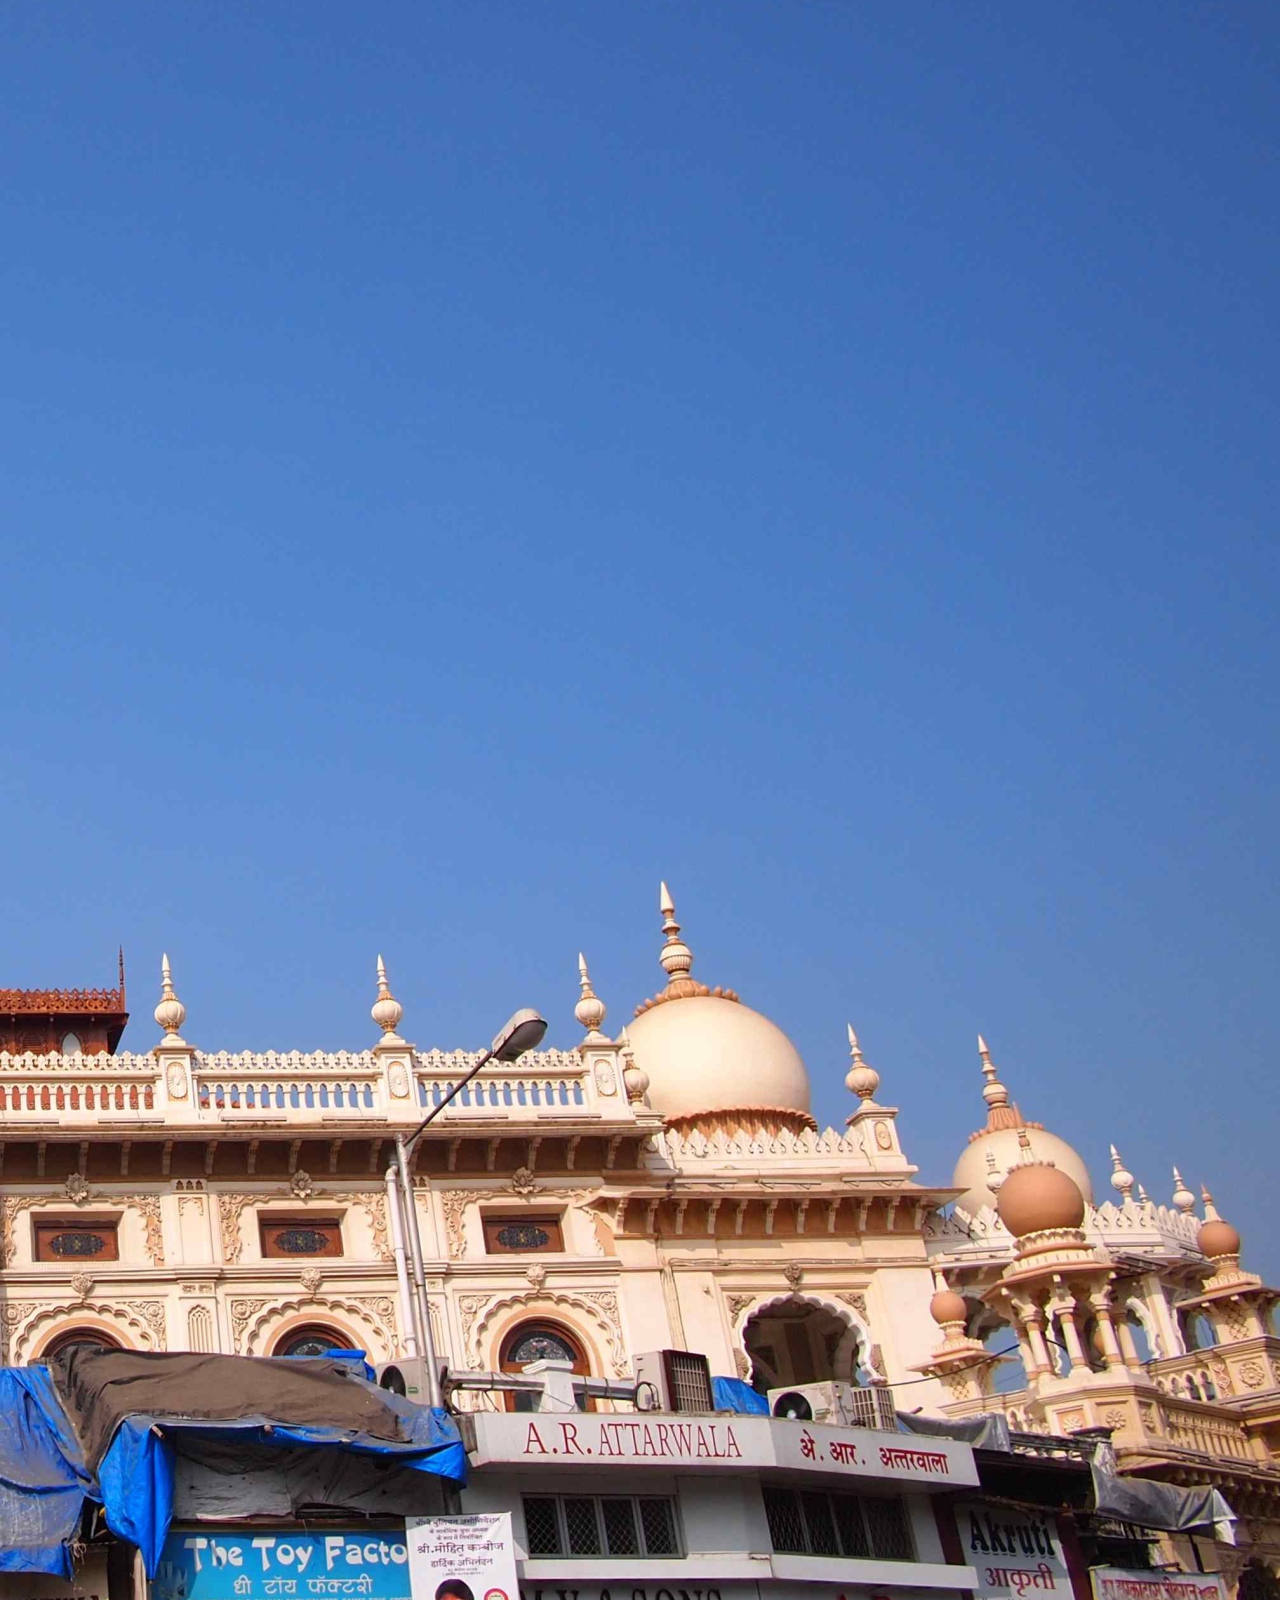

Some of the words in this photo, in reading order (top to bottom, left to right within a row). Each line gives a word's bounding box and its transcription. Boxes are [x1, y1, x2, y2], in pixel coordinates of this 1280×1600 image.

[598, 1422, 743, 1458] ATTARWALA
[969, 1509, 1056, 1557] Akruti
[184, 1536, 243, 1573] The
[252, 1536, 314, 1573] Toy
[261, 1575, 297, 1595] टॉय
[985, 1562, 1057, 1598] आकृती
